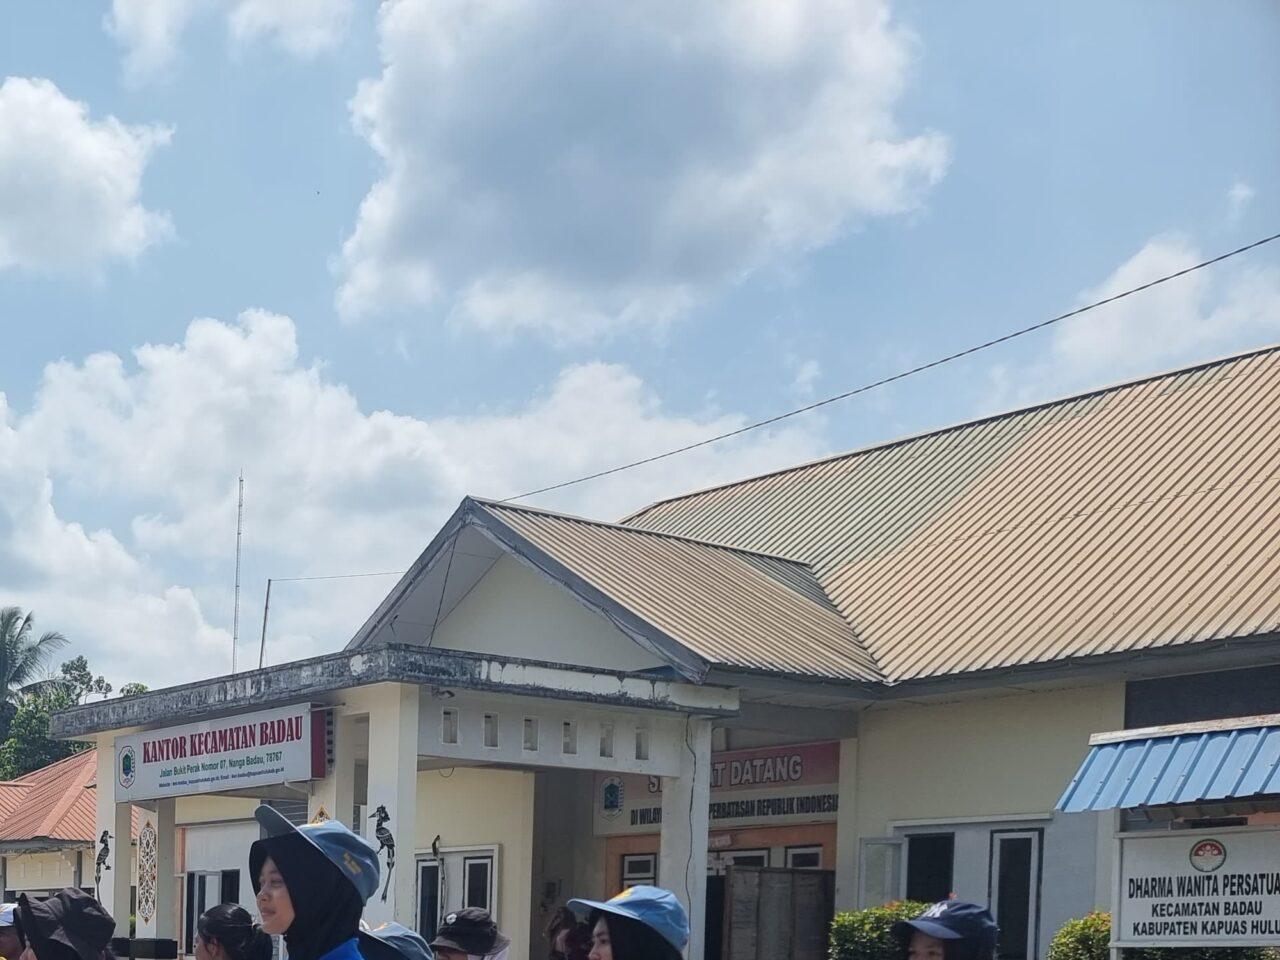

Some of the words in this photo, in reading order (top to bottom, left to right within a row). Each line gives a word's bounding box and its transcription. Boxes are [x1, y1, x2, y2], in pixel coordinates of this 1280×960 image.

[143, 736, 187, 764] KANTOR
[190, 723, 256, 757] KECAMATAN
[260, 716, 303, 746] BADAU
[730, 754, 802, 786] DATANG
[756, 796, 795, 816] REPUBLIK
[1128, 876, 1173, 899] DHARMA
[1177, 874, 1219, 897] WANITA
[1152, 902, 1219, 917] KECAMATAN
[1224, 900, 1263, 916] BADAU
[1133, 921, 1198, 936] KABUPATEN
[1202, 920, 1247, 935] KAPUAS
[1251, 919, 1280, 934] HULU
